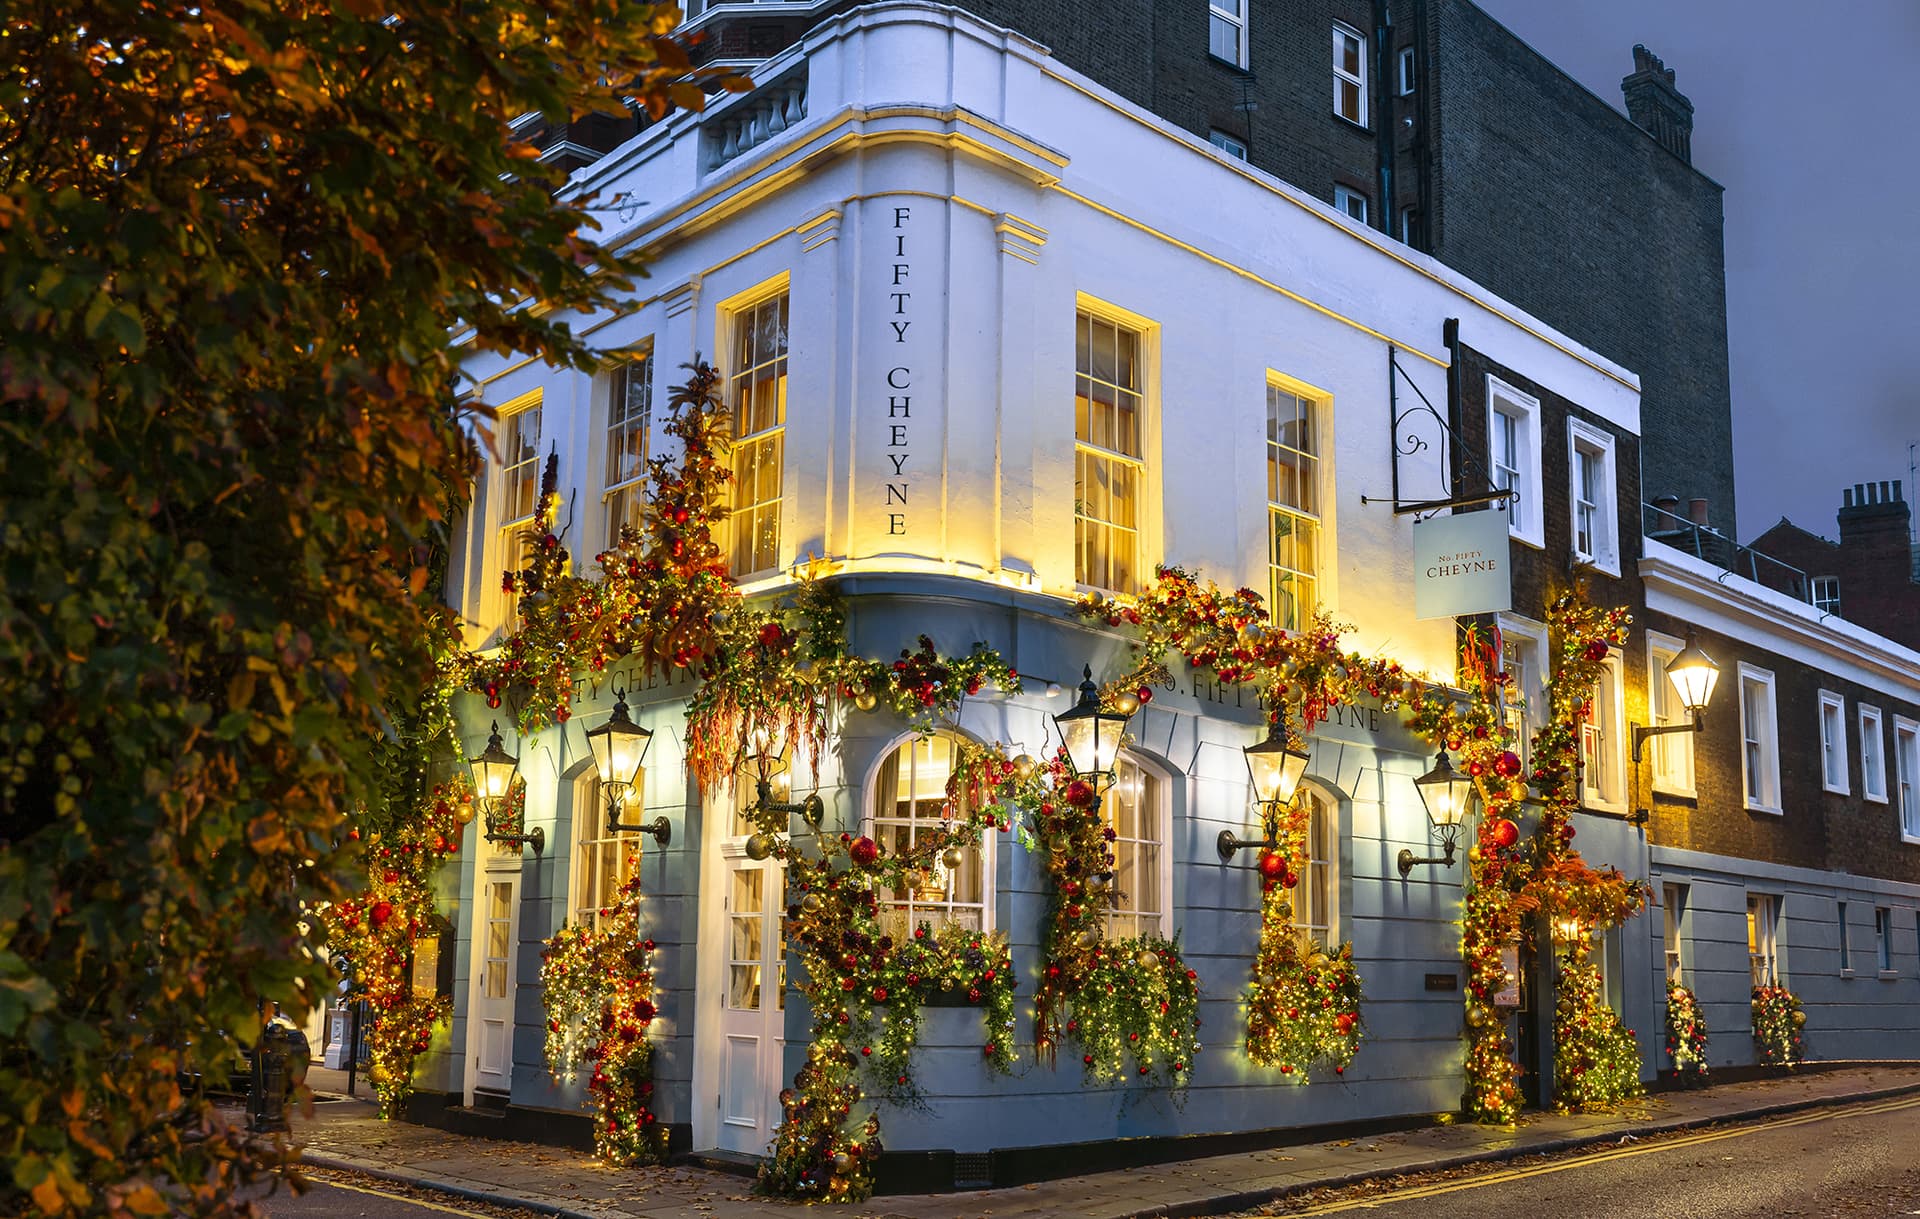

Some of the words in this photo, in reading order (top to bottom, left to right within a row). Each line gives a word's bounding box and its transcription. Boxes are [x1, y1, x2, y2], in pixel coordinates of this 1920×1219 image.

[889, 207, 911, 343] FIFTY
[886, 367, 911, 535] CHEYNE
[1427, 560, 1496, 578] CHEYNE
[1456, 551, 1482, 560] FIFTY
[611, 660, 697, 696] CHEYN
